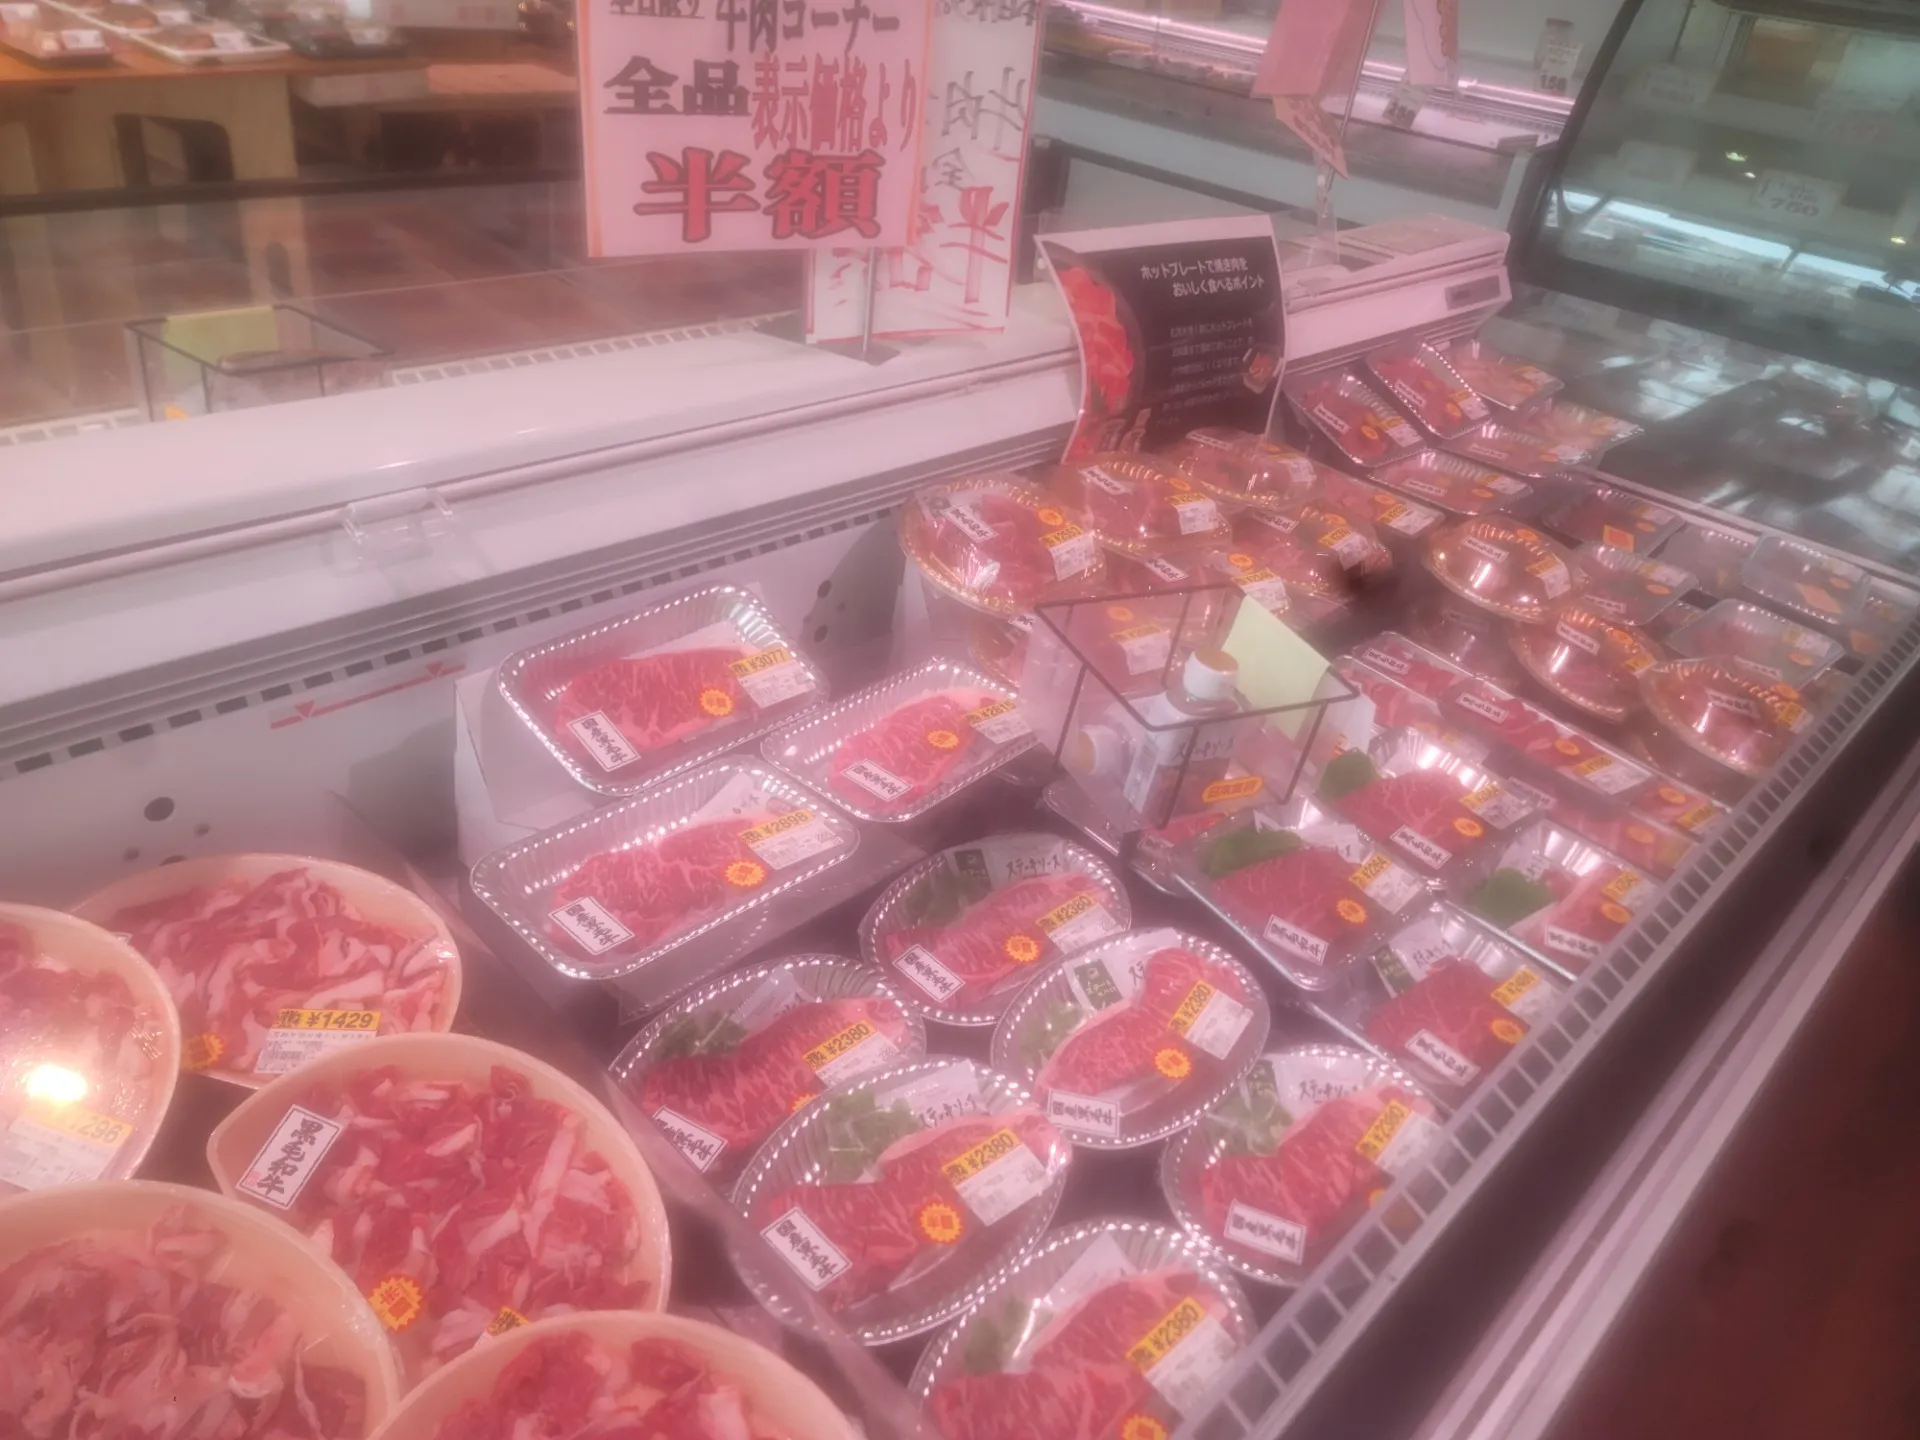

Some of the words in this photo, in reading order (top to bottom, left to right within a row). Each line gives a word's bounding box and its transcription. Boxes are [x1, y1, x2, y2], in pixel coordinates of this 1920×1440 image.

[633, 147, 886, 243] 半額
[1172, 274, 1265, 298] おいしく食べるポイント
[256, 1117, 324, 1198] 黒毛和牛
